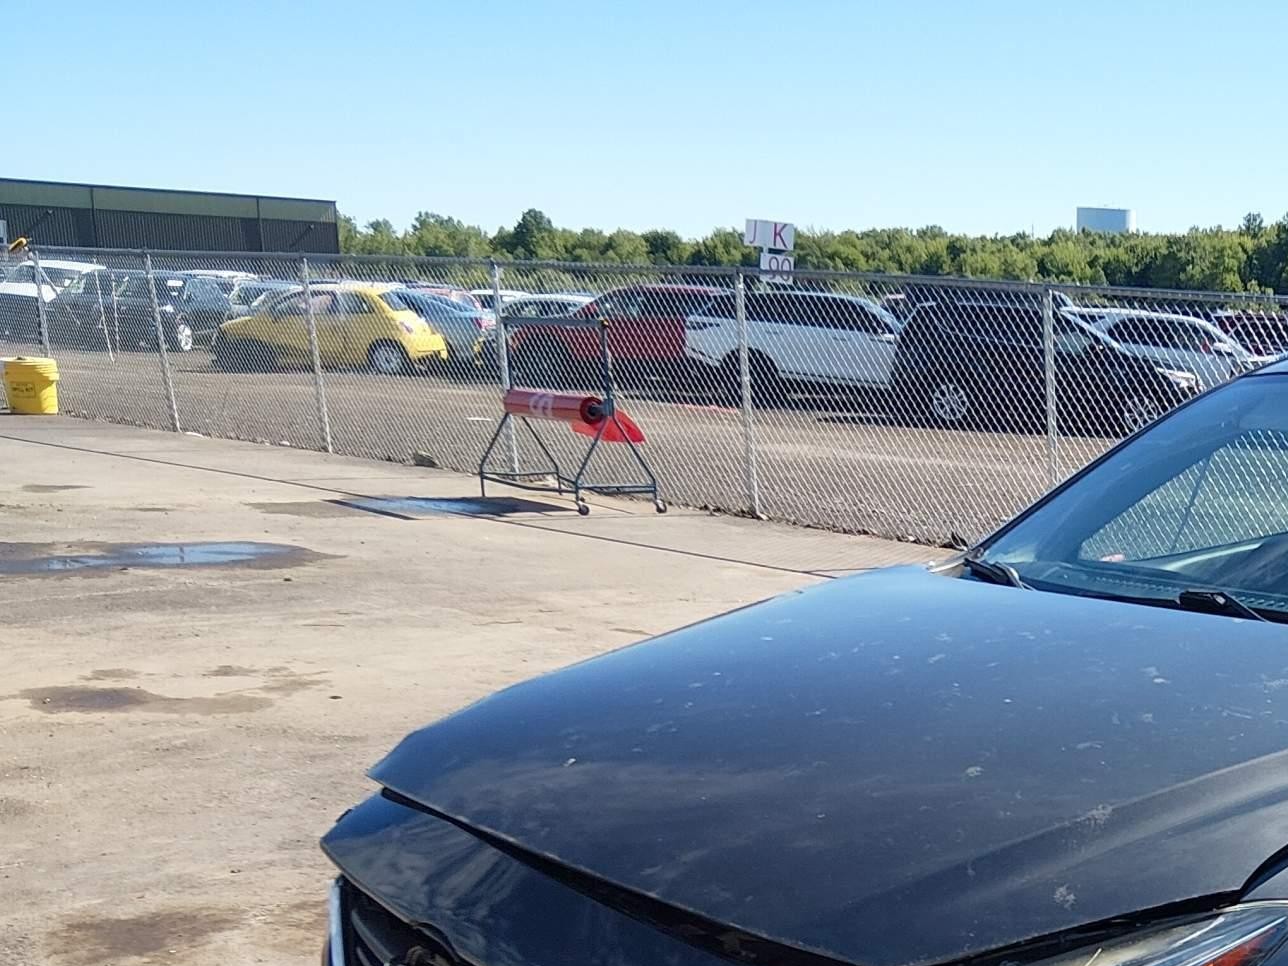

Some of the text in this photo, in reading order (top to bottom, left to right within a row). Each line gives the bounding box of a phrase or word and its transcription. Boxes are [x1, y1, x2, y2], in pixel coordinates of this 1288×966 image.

[748, 219, 758, 245] J
[773, 222, 788, 249] K
[768, 256, 792, 282] 90
